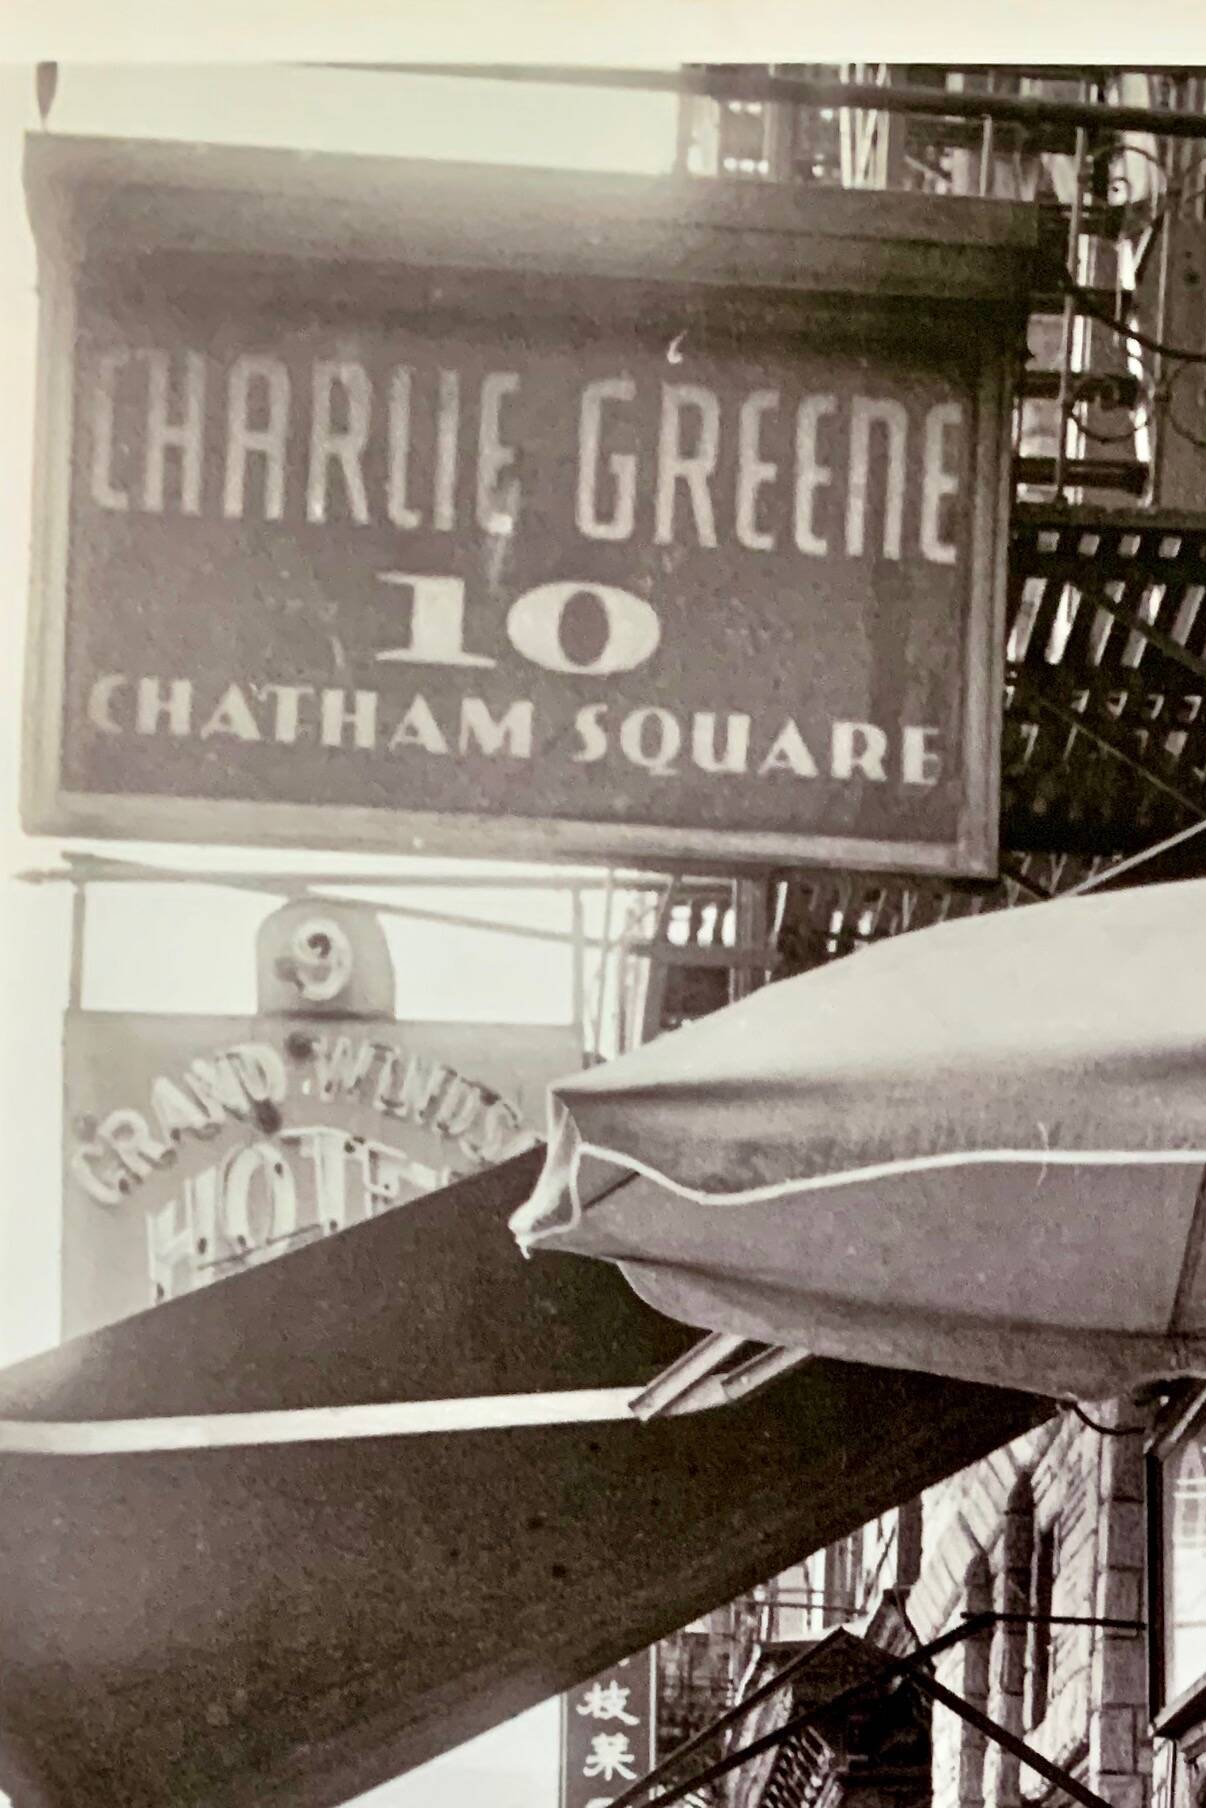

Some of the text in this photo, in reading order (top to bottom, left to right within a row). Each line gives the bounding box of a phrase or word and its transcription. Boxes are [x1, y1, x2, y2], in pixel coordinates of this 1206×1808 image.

[86, 349, 964, 566] CHARLIE GREENE
[373, 570, 661, 675] 10
[86, 674, 942, 787] CHATHAM SQUARE
[289, 916, 352, 1001] 9
[72, 1042, 288, 1206] GRAND
